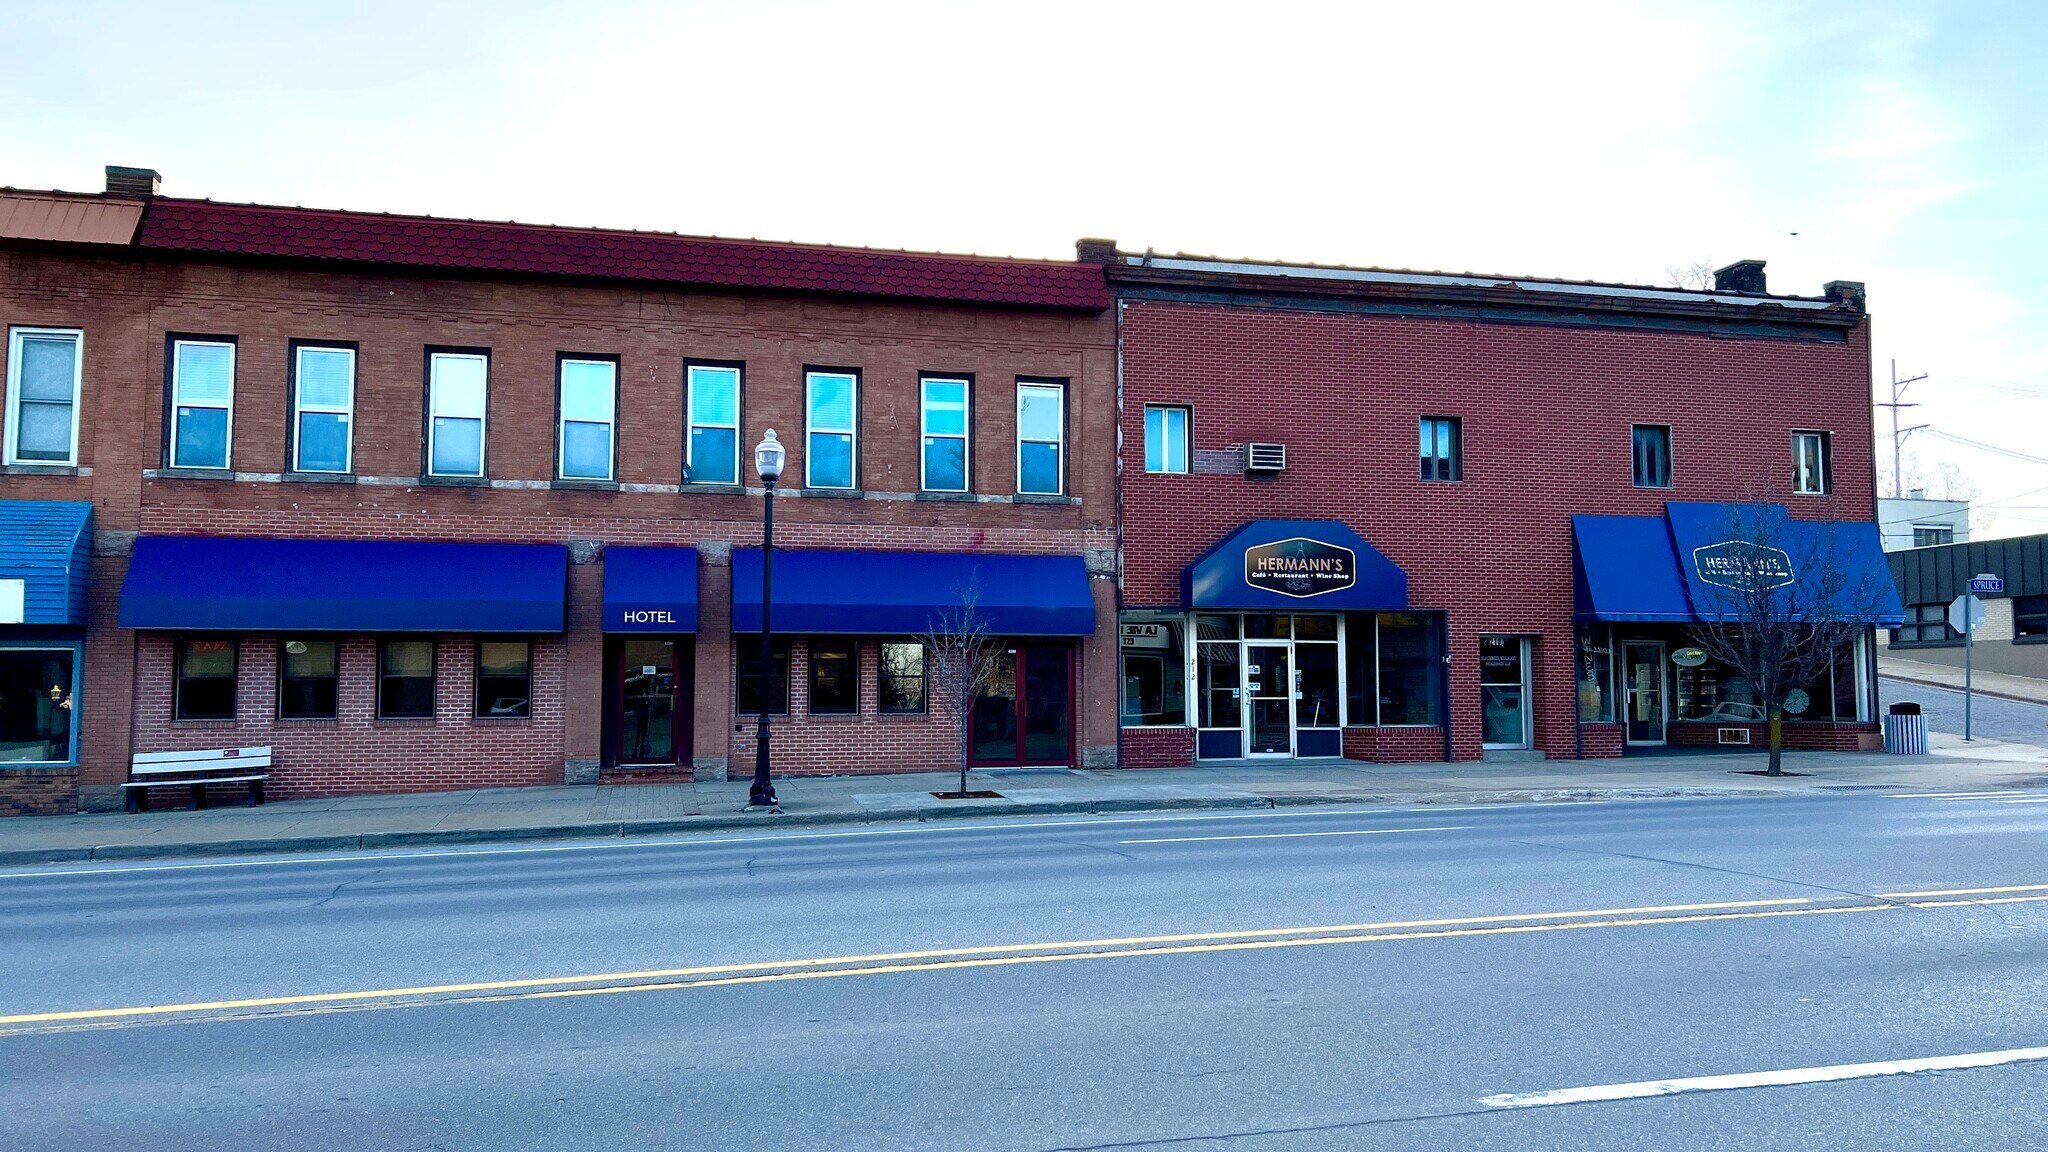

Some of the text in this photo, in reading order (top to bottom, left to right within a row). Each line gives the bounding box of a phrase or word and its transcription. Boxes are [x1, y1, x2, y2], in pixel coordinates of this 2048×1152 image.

[1257, 557, 1343, 572] HERMANN'S
[1973, 580, 2000, 590] SPRUCE
[624, 610, 677, 623] HOTEL
